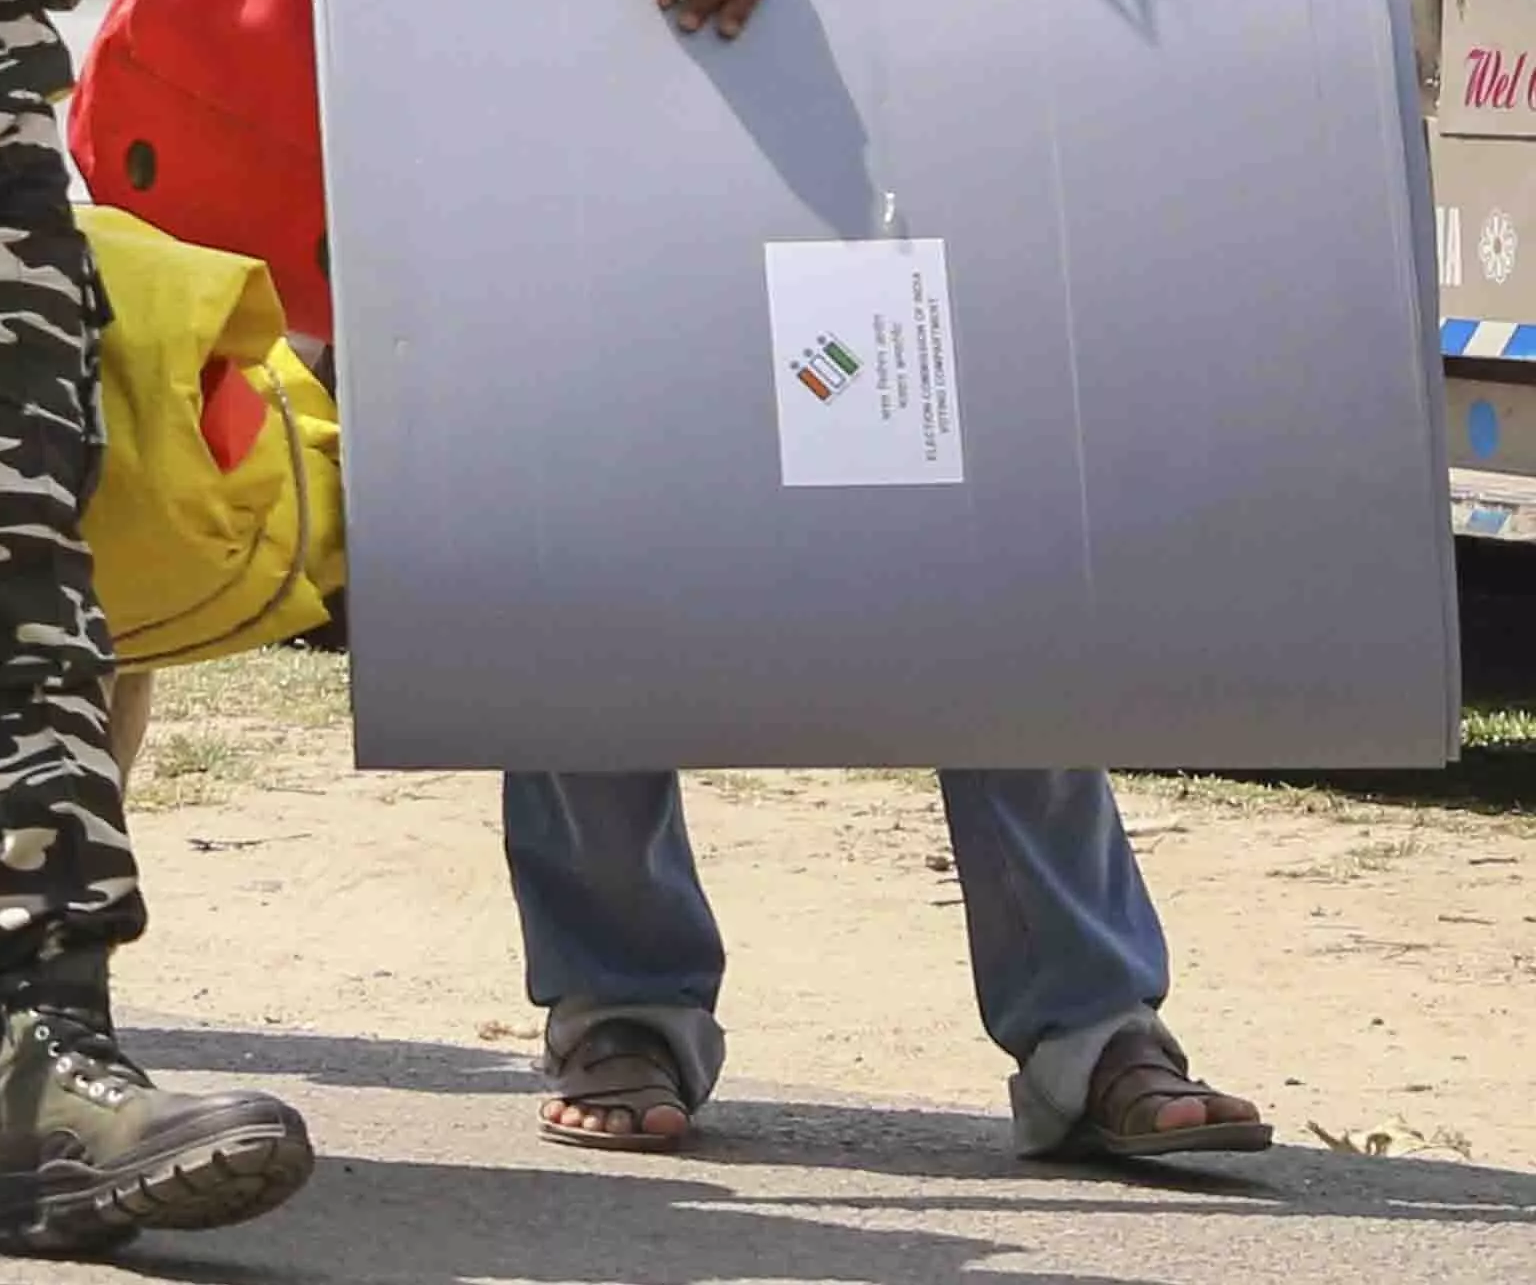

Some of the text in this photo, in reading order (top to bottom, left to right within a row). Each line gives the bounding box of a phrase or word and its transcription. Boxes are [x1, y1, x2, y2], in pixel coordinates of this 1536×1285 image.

[1463, 48, 1528, 110] Wel
[911, 272, 938, 462] ELECTION COMMISSION OF INDIA
[927, 298, 951, 434] VOTING COMPARTMENT
